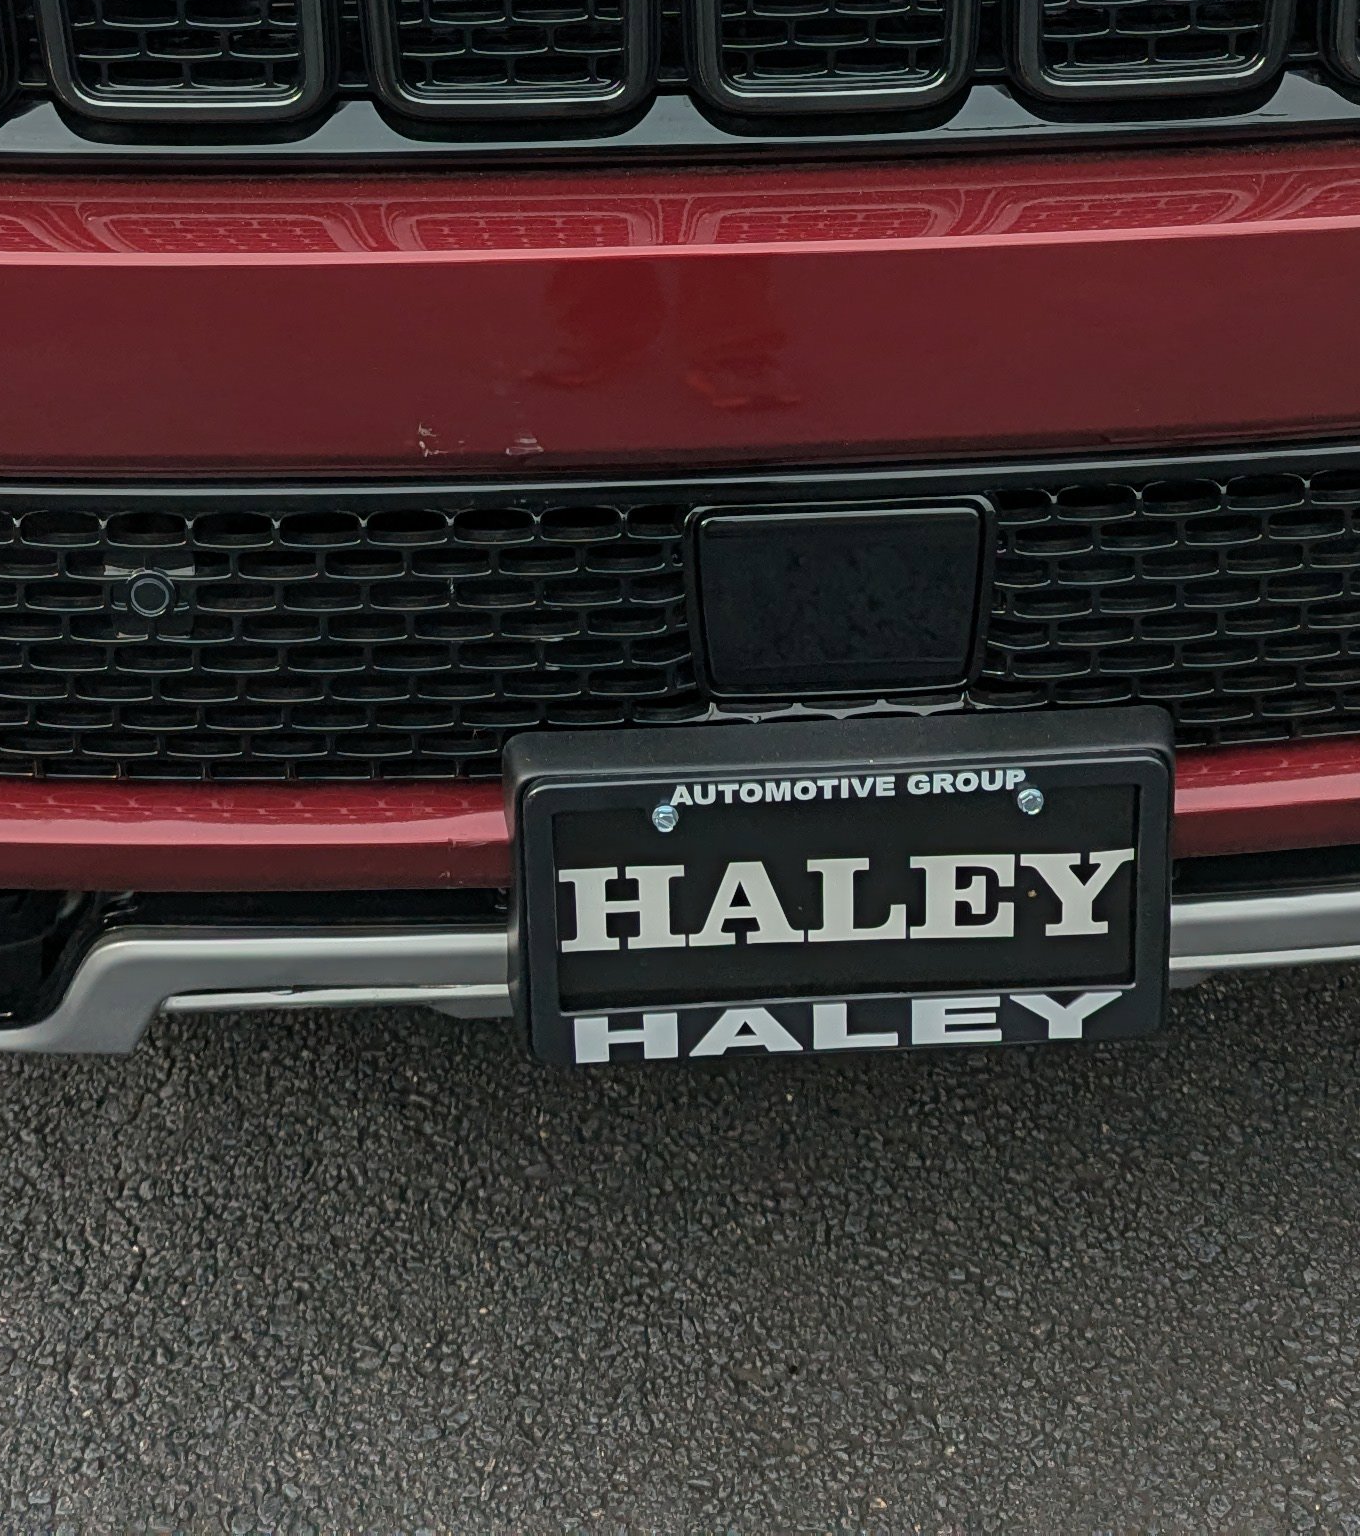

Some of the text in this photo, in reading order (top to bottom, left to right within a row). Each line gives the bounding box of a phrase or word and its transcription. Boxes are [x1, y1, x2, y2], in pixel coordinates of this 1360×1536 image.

[670, 768, 1027, 807] AUTOMOTIVE GROUP
[558, 848, 1136, 953] HALEY
[574, 991, 1123, 1064] HALEY
